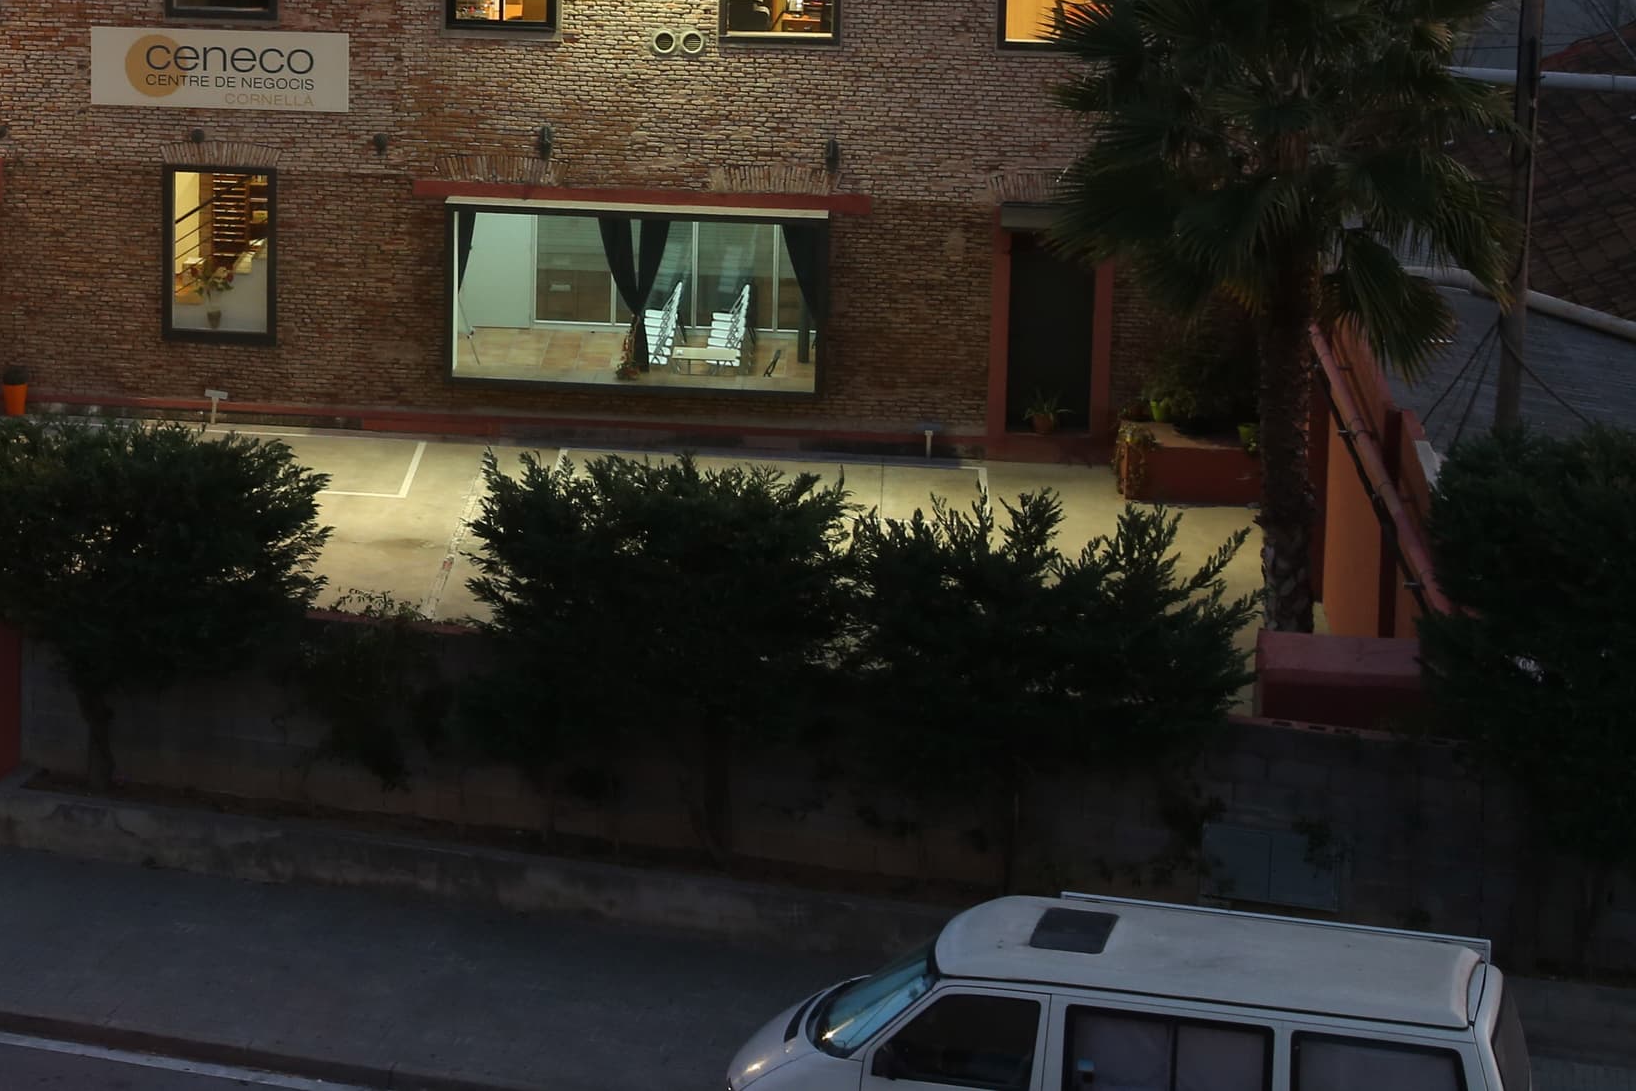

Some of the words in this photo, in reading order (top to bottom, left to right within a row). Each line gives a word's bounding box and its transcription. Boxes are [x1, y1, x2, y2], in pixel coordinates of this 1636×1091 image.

[146, 44, 314, 75] ceneco
[145, 73, 210, 88] CENTRE
[215, 76, 237, 88] DE
[241, 76, 315, 91] NEGOCIS
